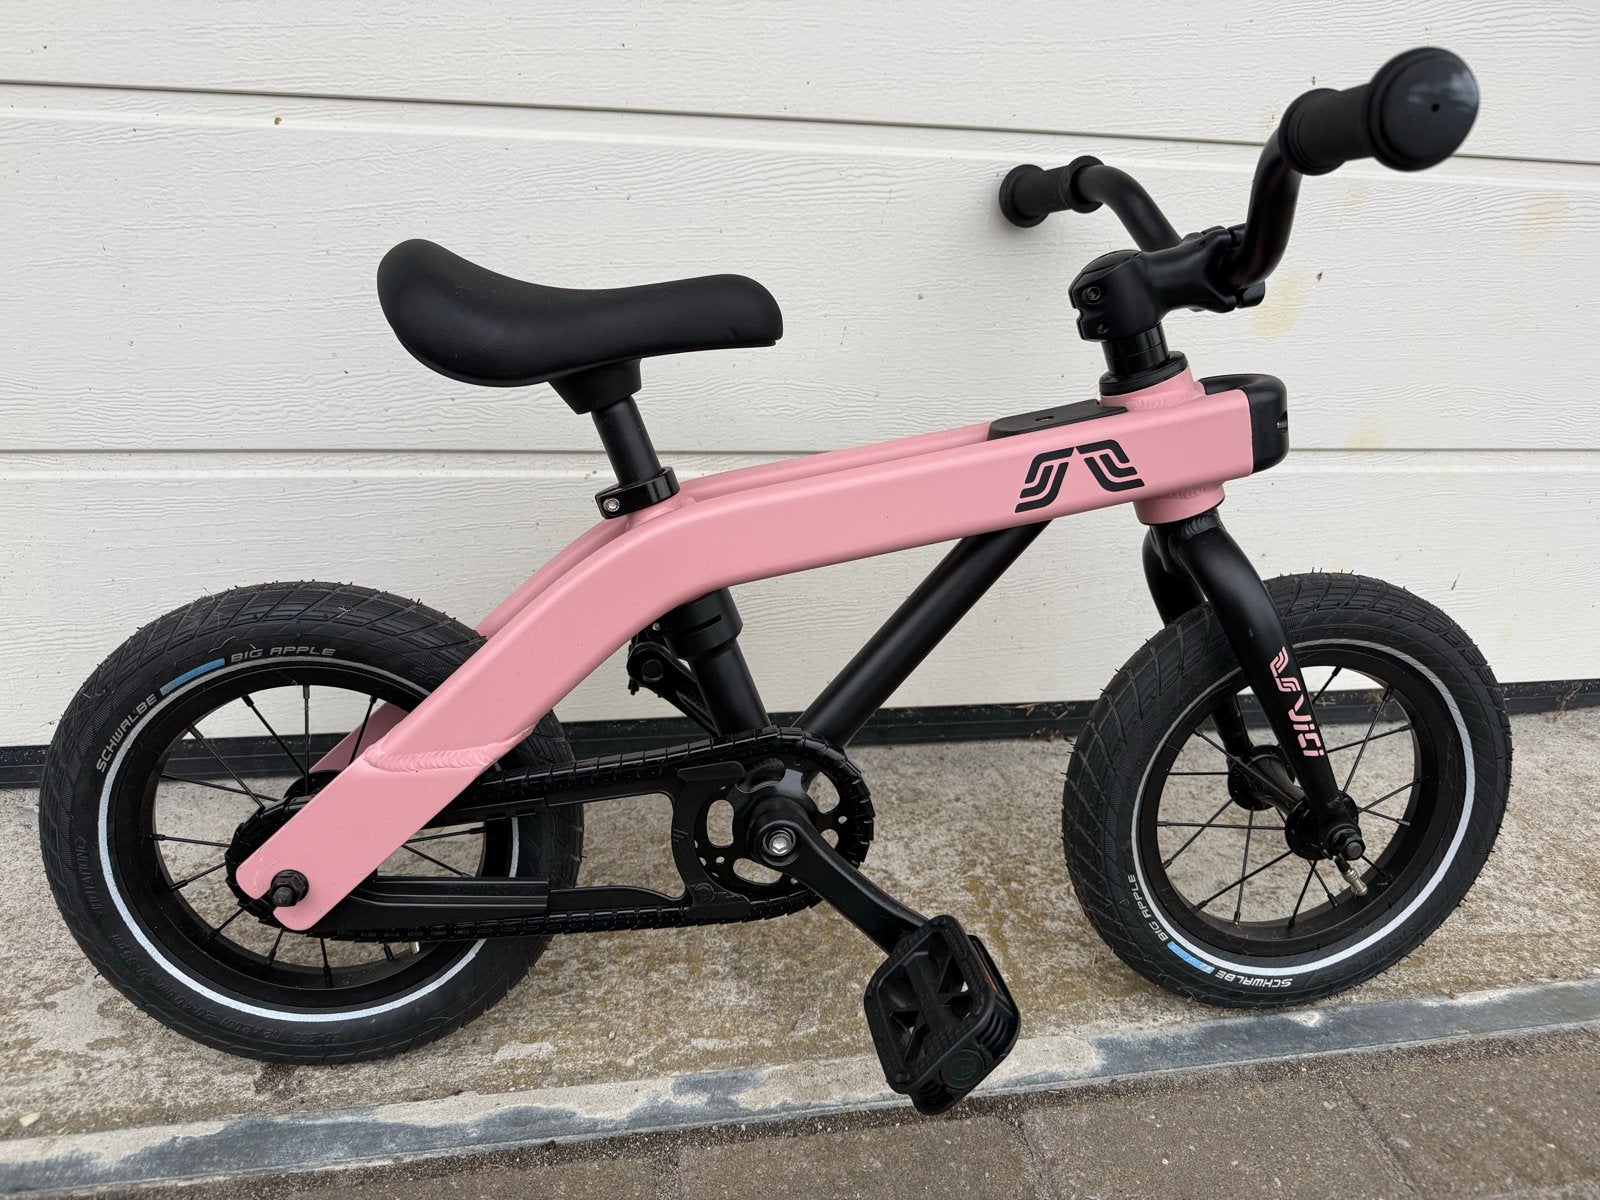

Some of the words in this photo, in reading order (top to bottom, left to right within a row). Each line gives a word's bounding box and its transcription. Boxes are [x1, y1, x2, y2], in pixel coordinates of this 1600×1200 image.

[231, 649, 263, 662] BIG
[269, 646, 336, 656] APPLE
[96, 693, 157, 773] SCHWALBE
[1127, 874, 1151, 919] APPLE
[1148, 921, 1169, 942] BIG
[1215, 969, 1293, 988] SCHWALBE
